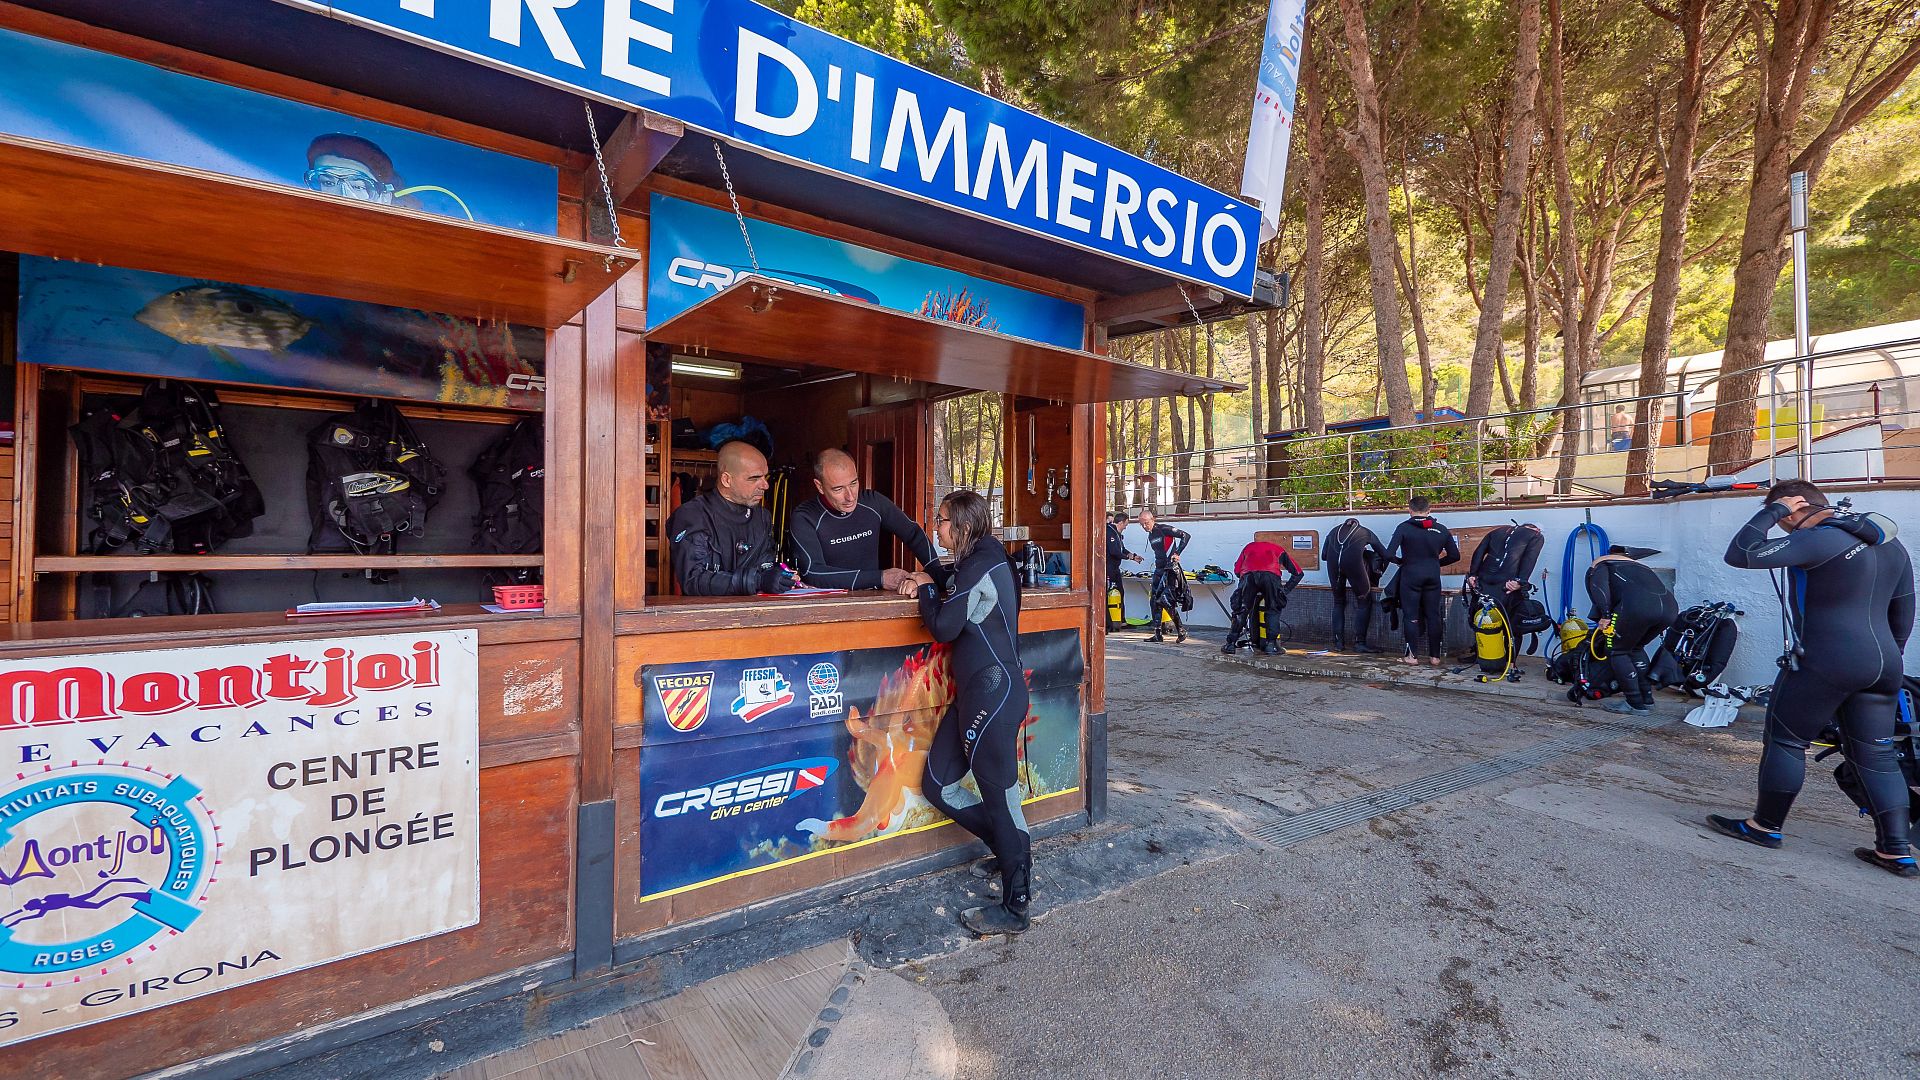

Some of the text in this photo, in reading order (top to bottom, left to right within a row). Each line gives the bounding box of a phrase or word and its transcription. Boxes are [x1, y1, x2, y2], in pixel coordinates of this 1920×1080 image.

[735, 26, 1246, 278] D'IMMERSIÓ
[830, 529, 873, 545] SCUBAPRO
[659, 675, 711, 689] FECDAS
[744, 669, 776, 681] FFESSM
[811, 695, 842, 711] PADI
[811, 708, 842, 717] padi.com
[18, 702, 433, 763] E VACANCES
[267, 742, 439, 790] CENTRE
[331, 787, 386, 822] DE
[654, 770, 795, 818] CRESSI
[710, 795, 789, 821] dive center
[0, 781, 196, 891] TIVITATS SUBAQUATIQUES
[250, 812, 455, 877] PLONGÉE
[34, 939, 116, 966] ROSES
[80, 949, 281, 1007] GIRONA
